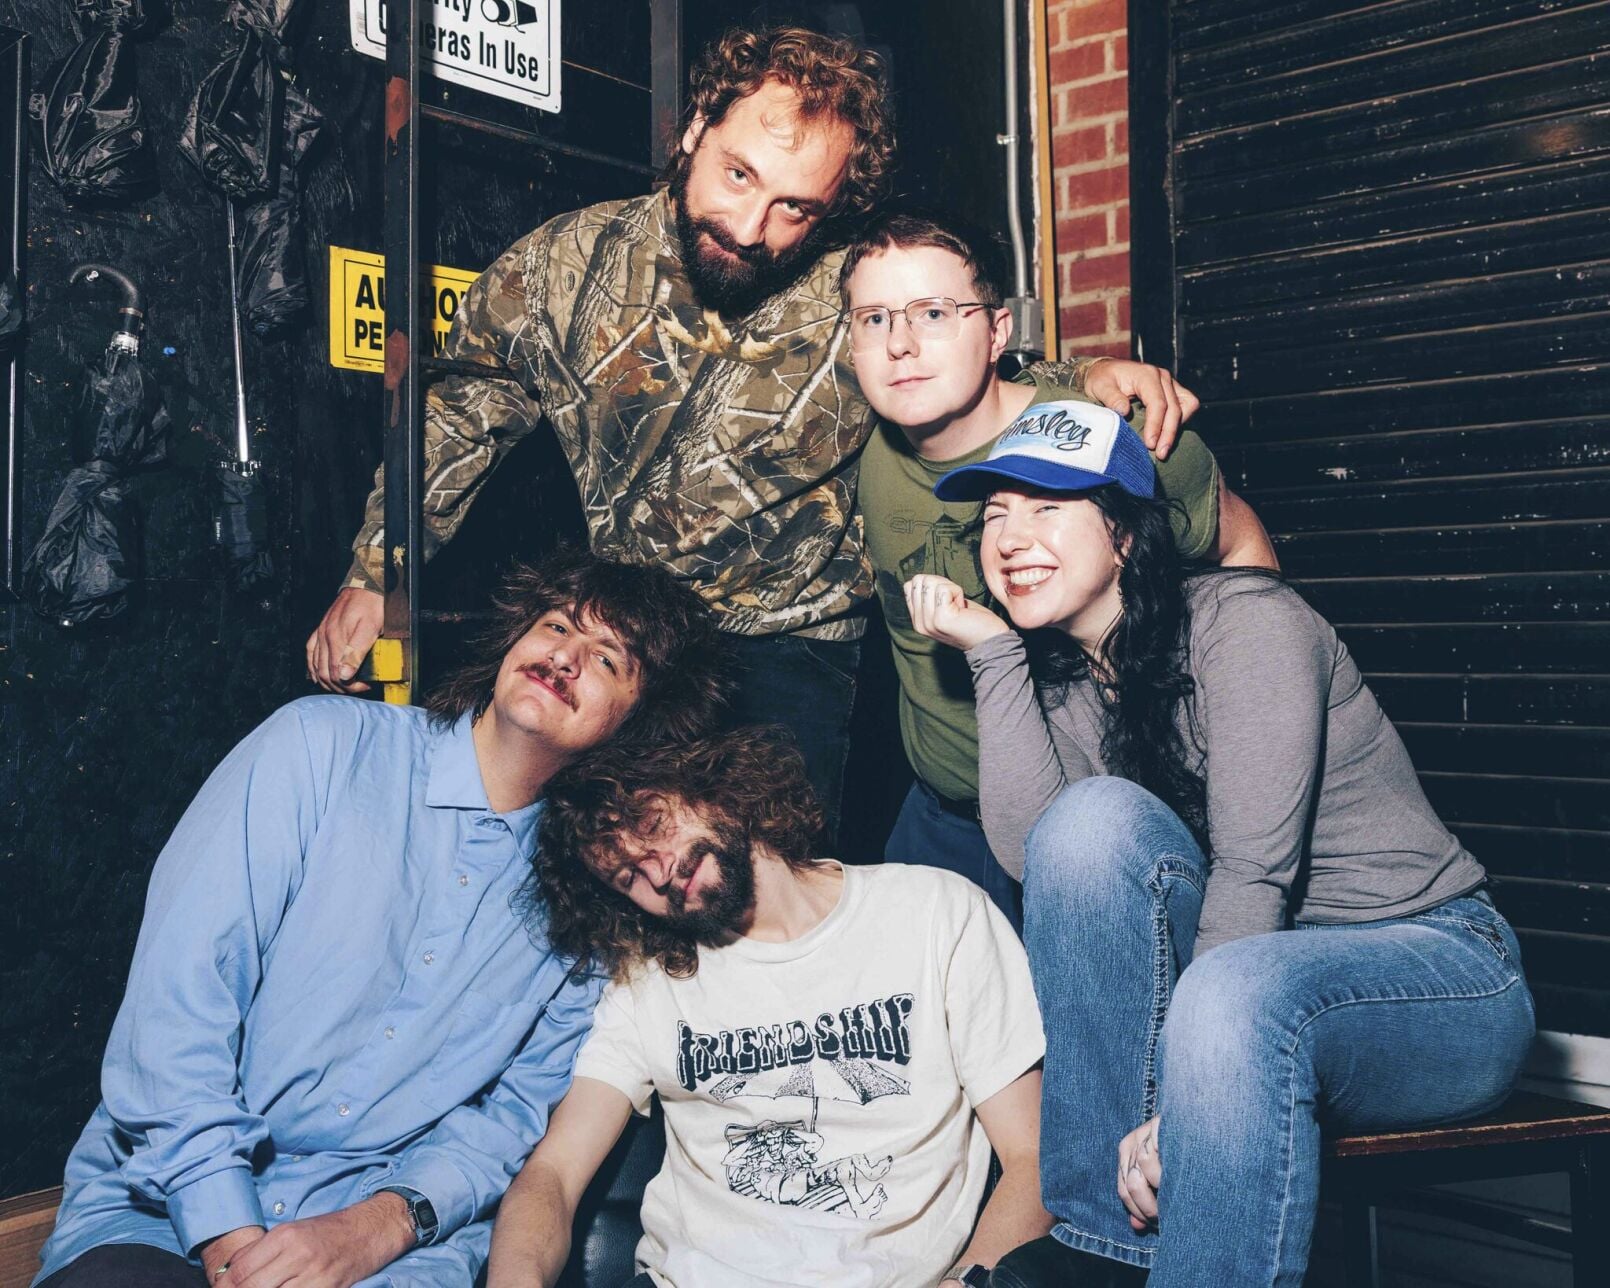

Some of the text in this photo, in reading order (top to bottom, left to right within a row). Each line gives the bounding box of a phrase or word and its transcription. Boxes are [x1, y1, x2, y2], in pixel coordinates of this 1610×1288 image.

[480, 31, 497, 69] In
[504, 39, 539, 82] Use
[677, 993, 916, 1092] FRIENDSHIP
